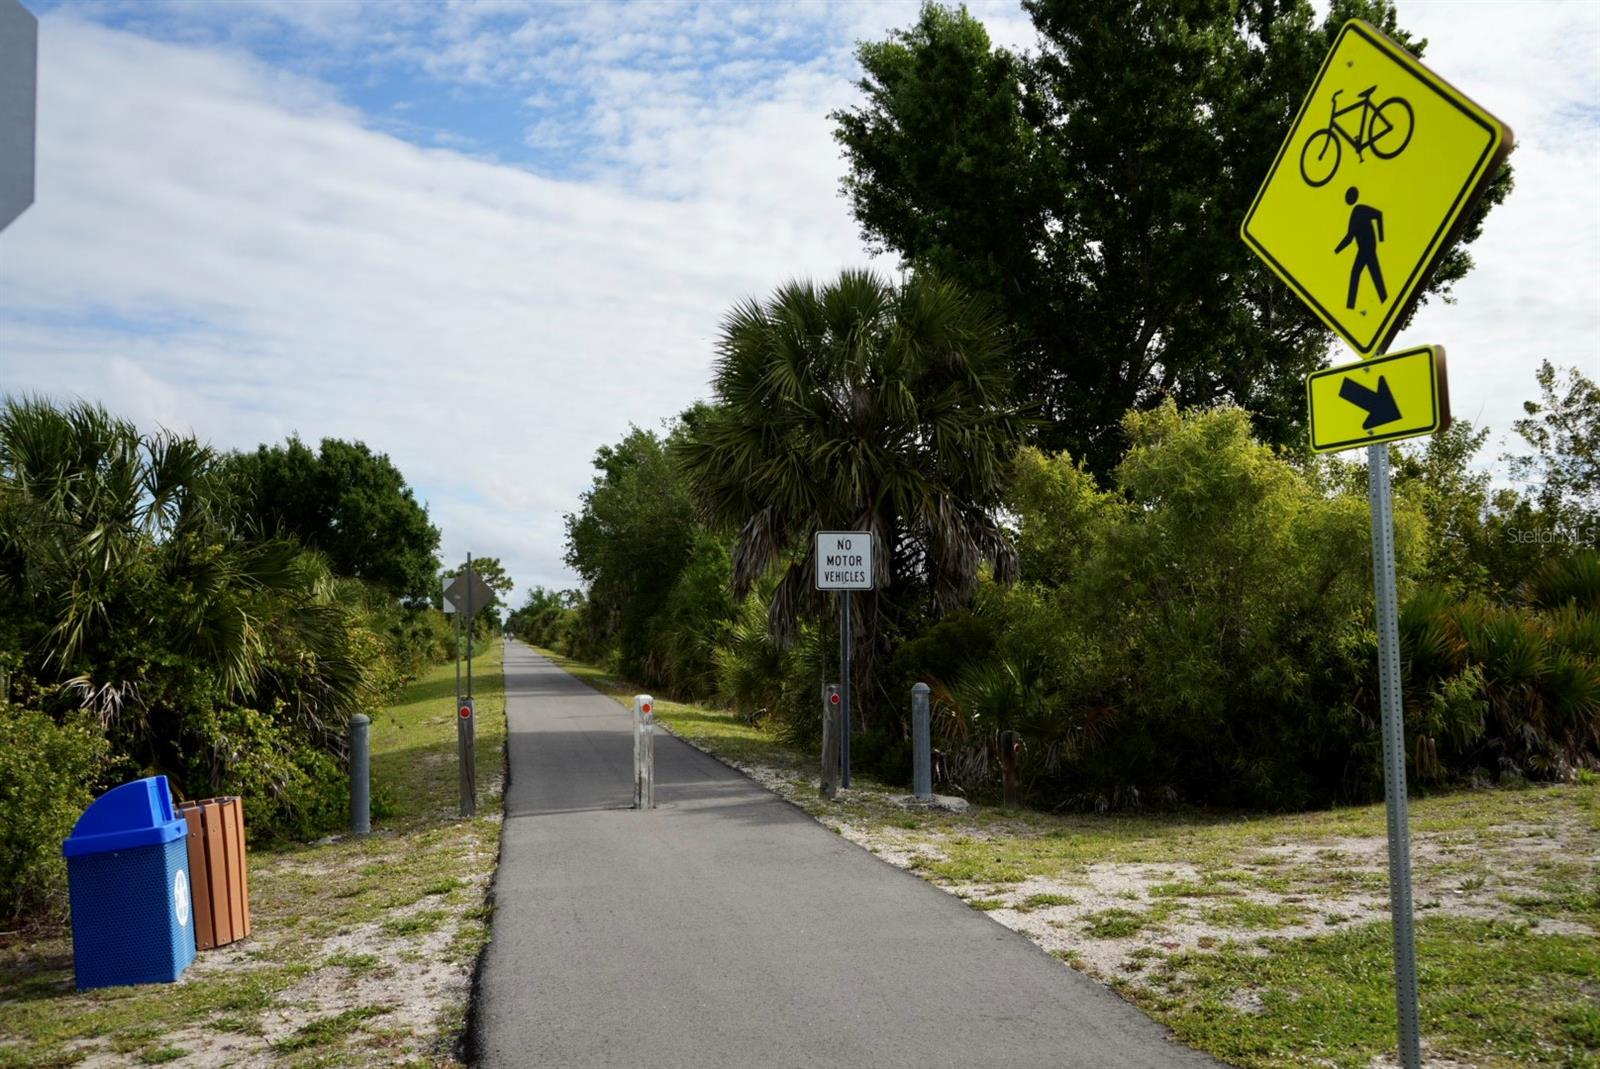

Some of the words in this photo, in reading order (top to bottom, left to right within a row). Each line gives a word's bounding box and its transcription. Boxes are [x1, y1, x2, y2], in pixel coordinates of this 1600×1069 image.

[837, 539, 852, 550] NO
[826, 555, 862, 566] MOTOR
[824, 571, 865, 582] VEHICLES
